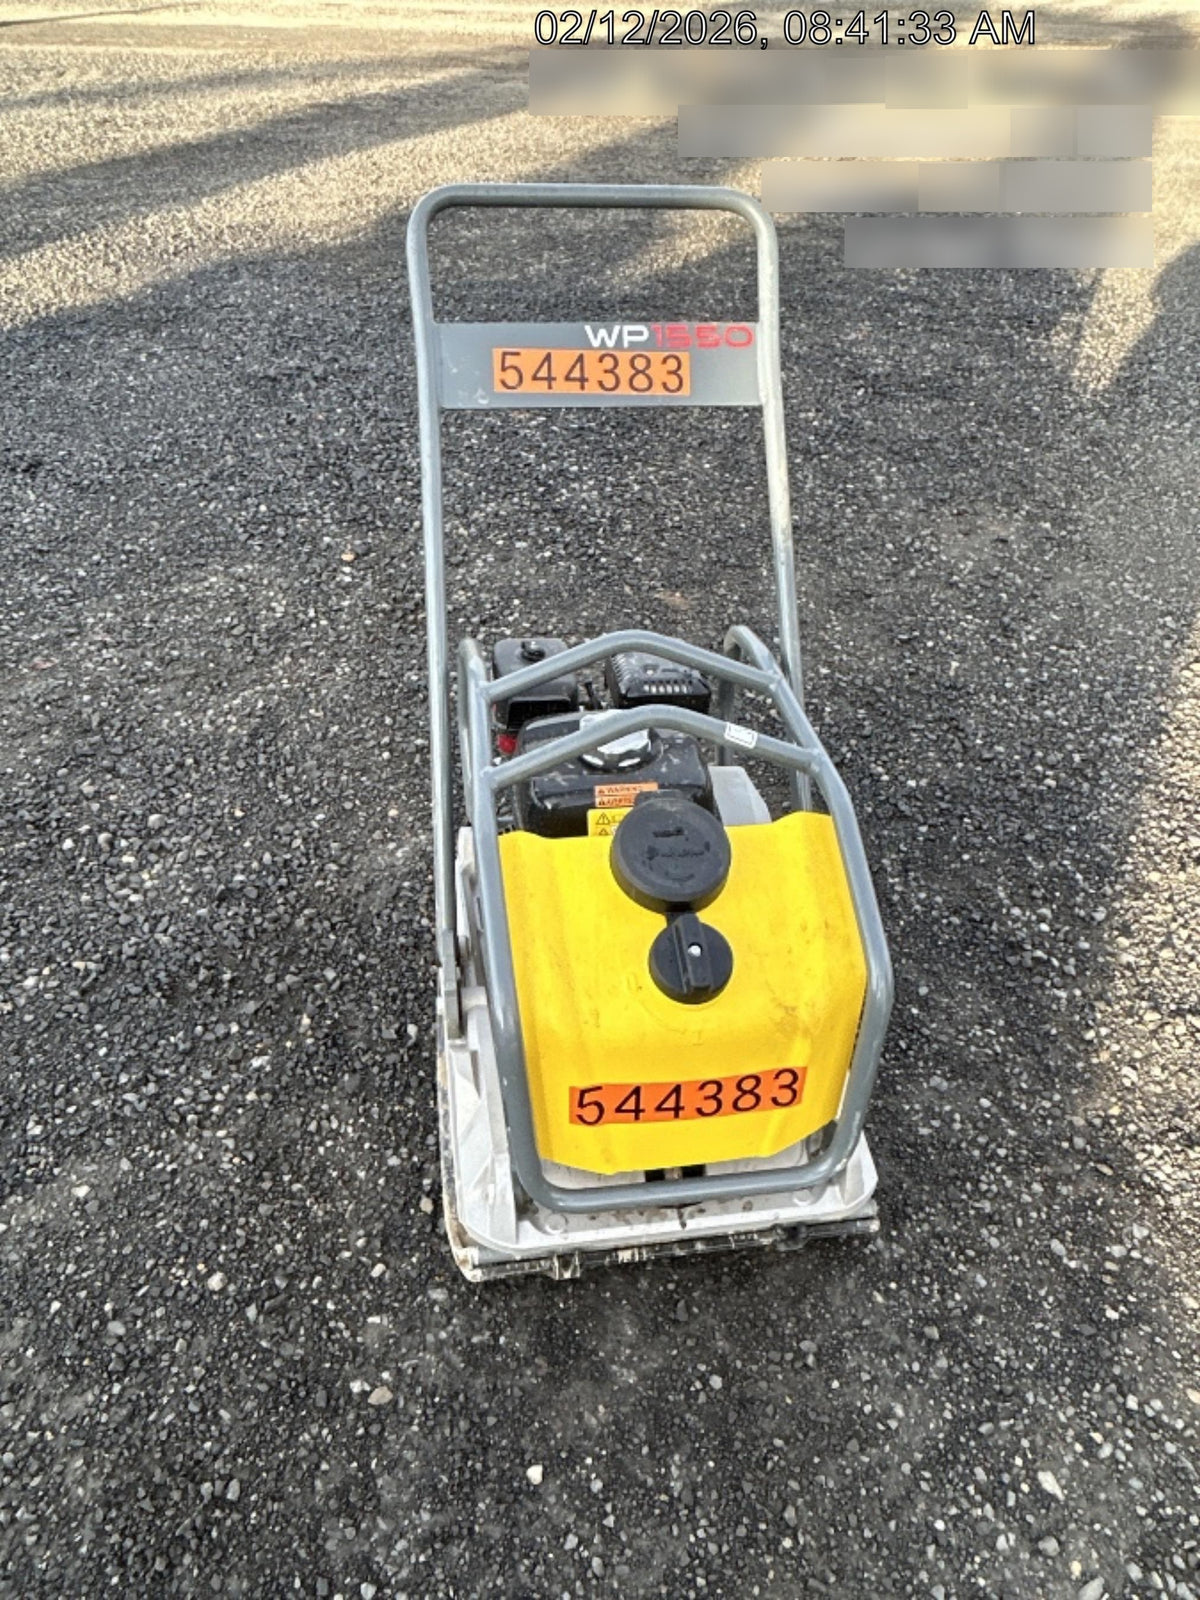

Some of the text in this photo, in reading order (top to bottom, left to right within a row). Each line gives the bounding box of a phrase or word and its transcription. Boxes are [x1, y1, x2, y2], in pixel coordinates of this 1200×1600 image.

[585, 325, 754, 348] WP1550
[500, 352, 684, 393] 544383
[576, 1068, 799, 1126] 544383
